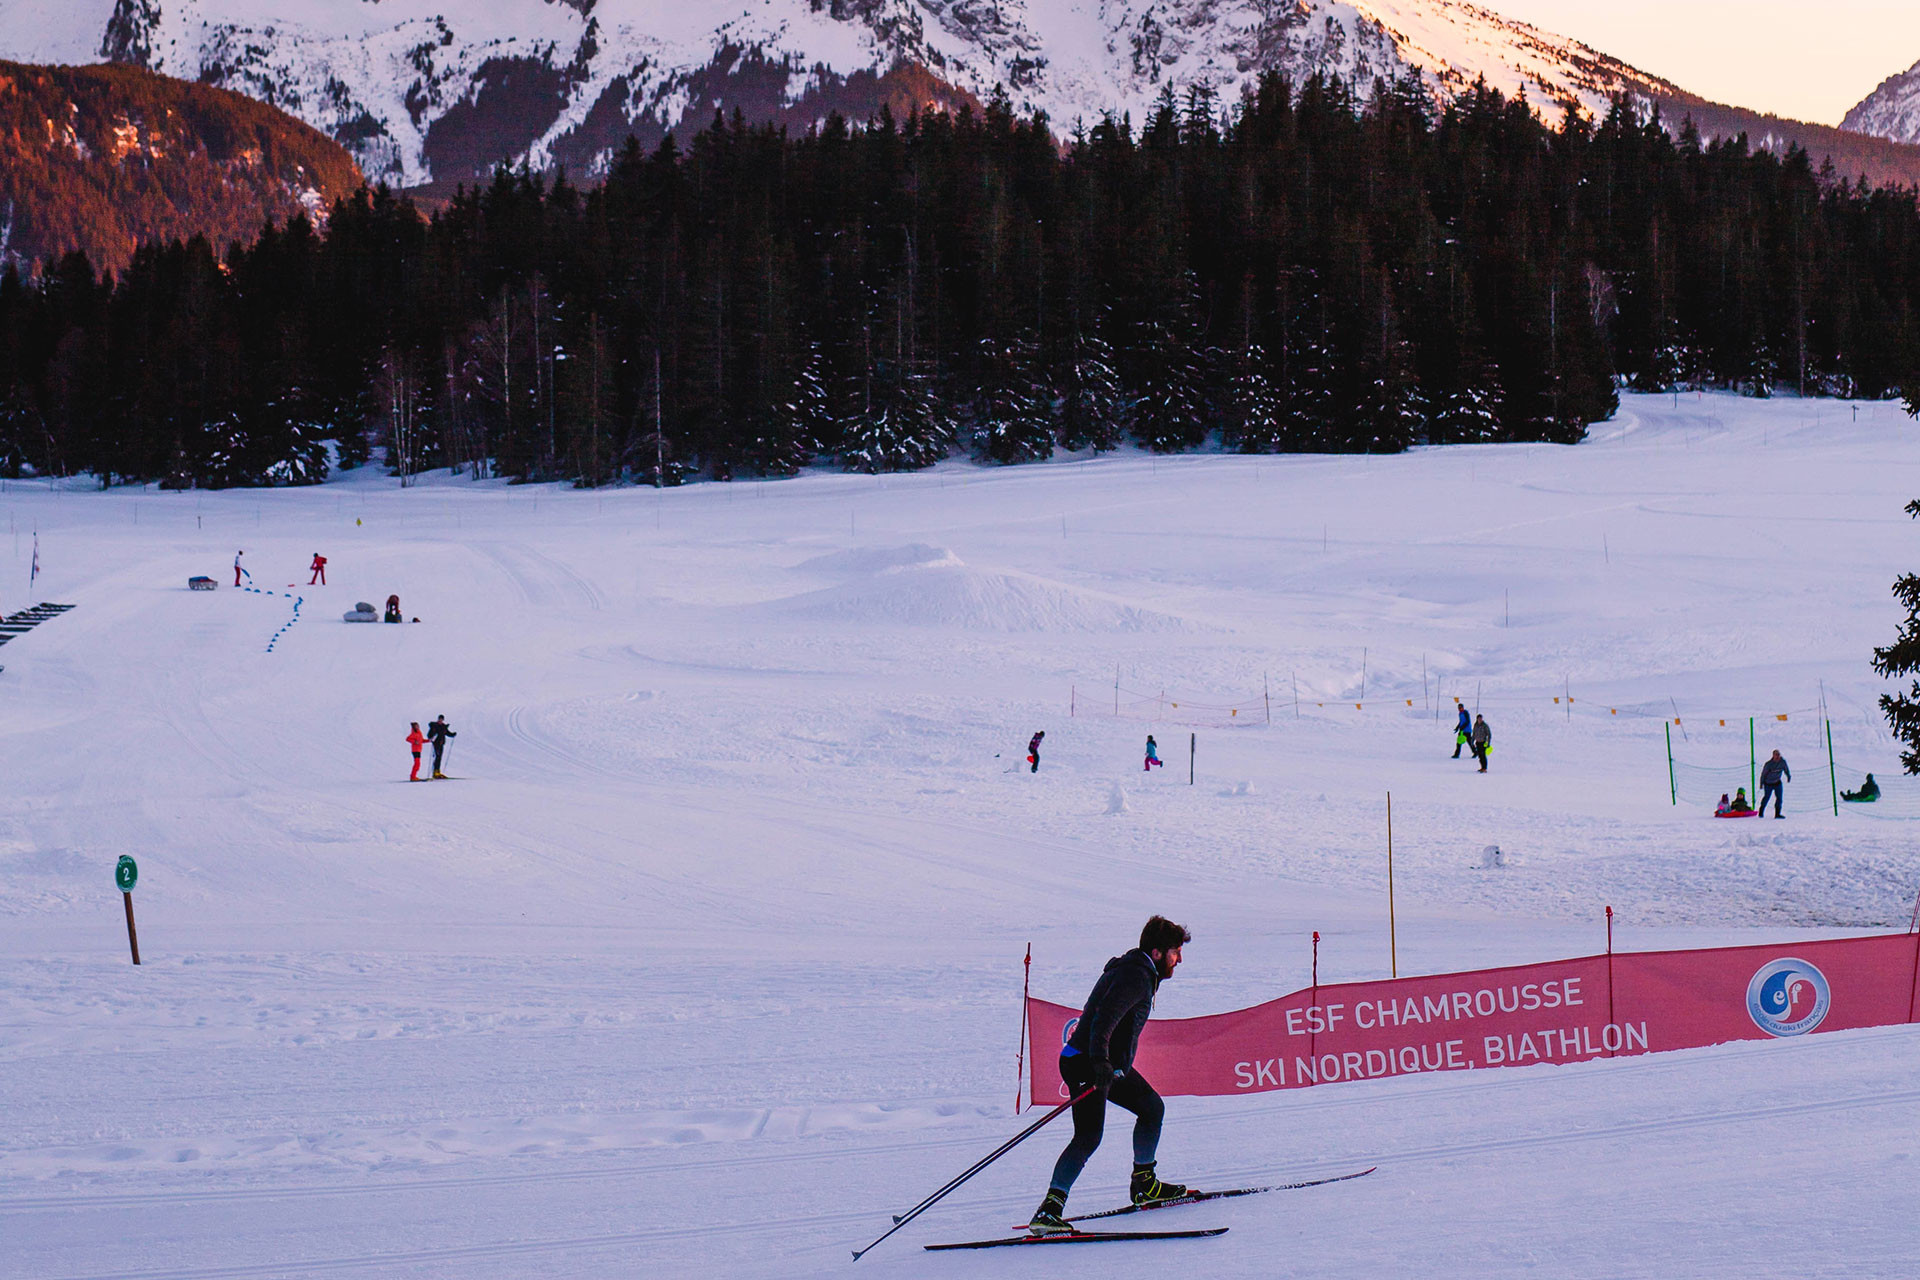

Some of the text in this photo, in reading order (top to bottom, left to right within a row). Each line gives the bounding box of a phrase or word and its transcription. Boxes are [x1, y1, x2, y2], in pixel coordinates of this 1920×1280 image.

[123, 867, 131, 881] 2
[1285, 977, 1584, 1036] ESF CHAMROUSSE
[1234, 1021, 1648, 1088] SKI NORDIQUE, BIATHLON
[1160, 1196, 1197, 1207] ROSSIGNOL
